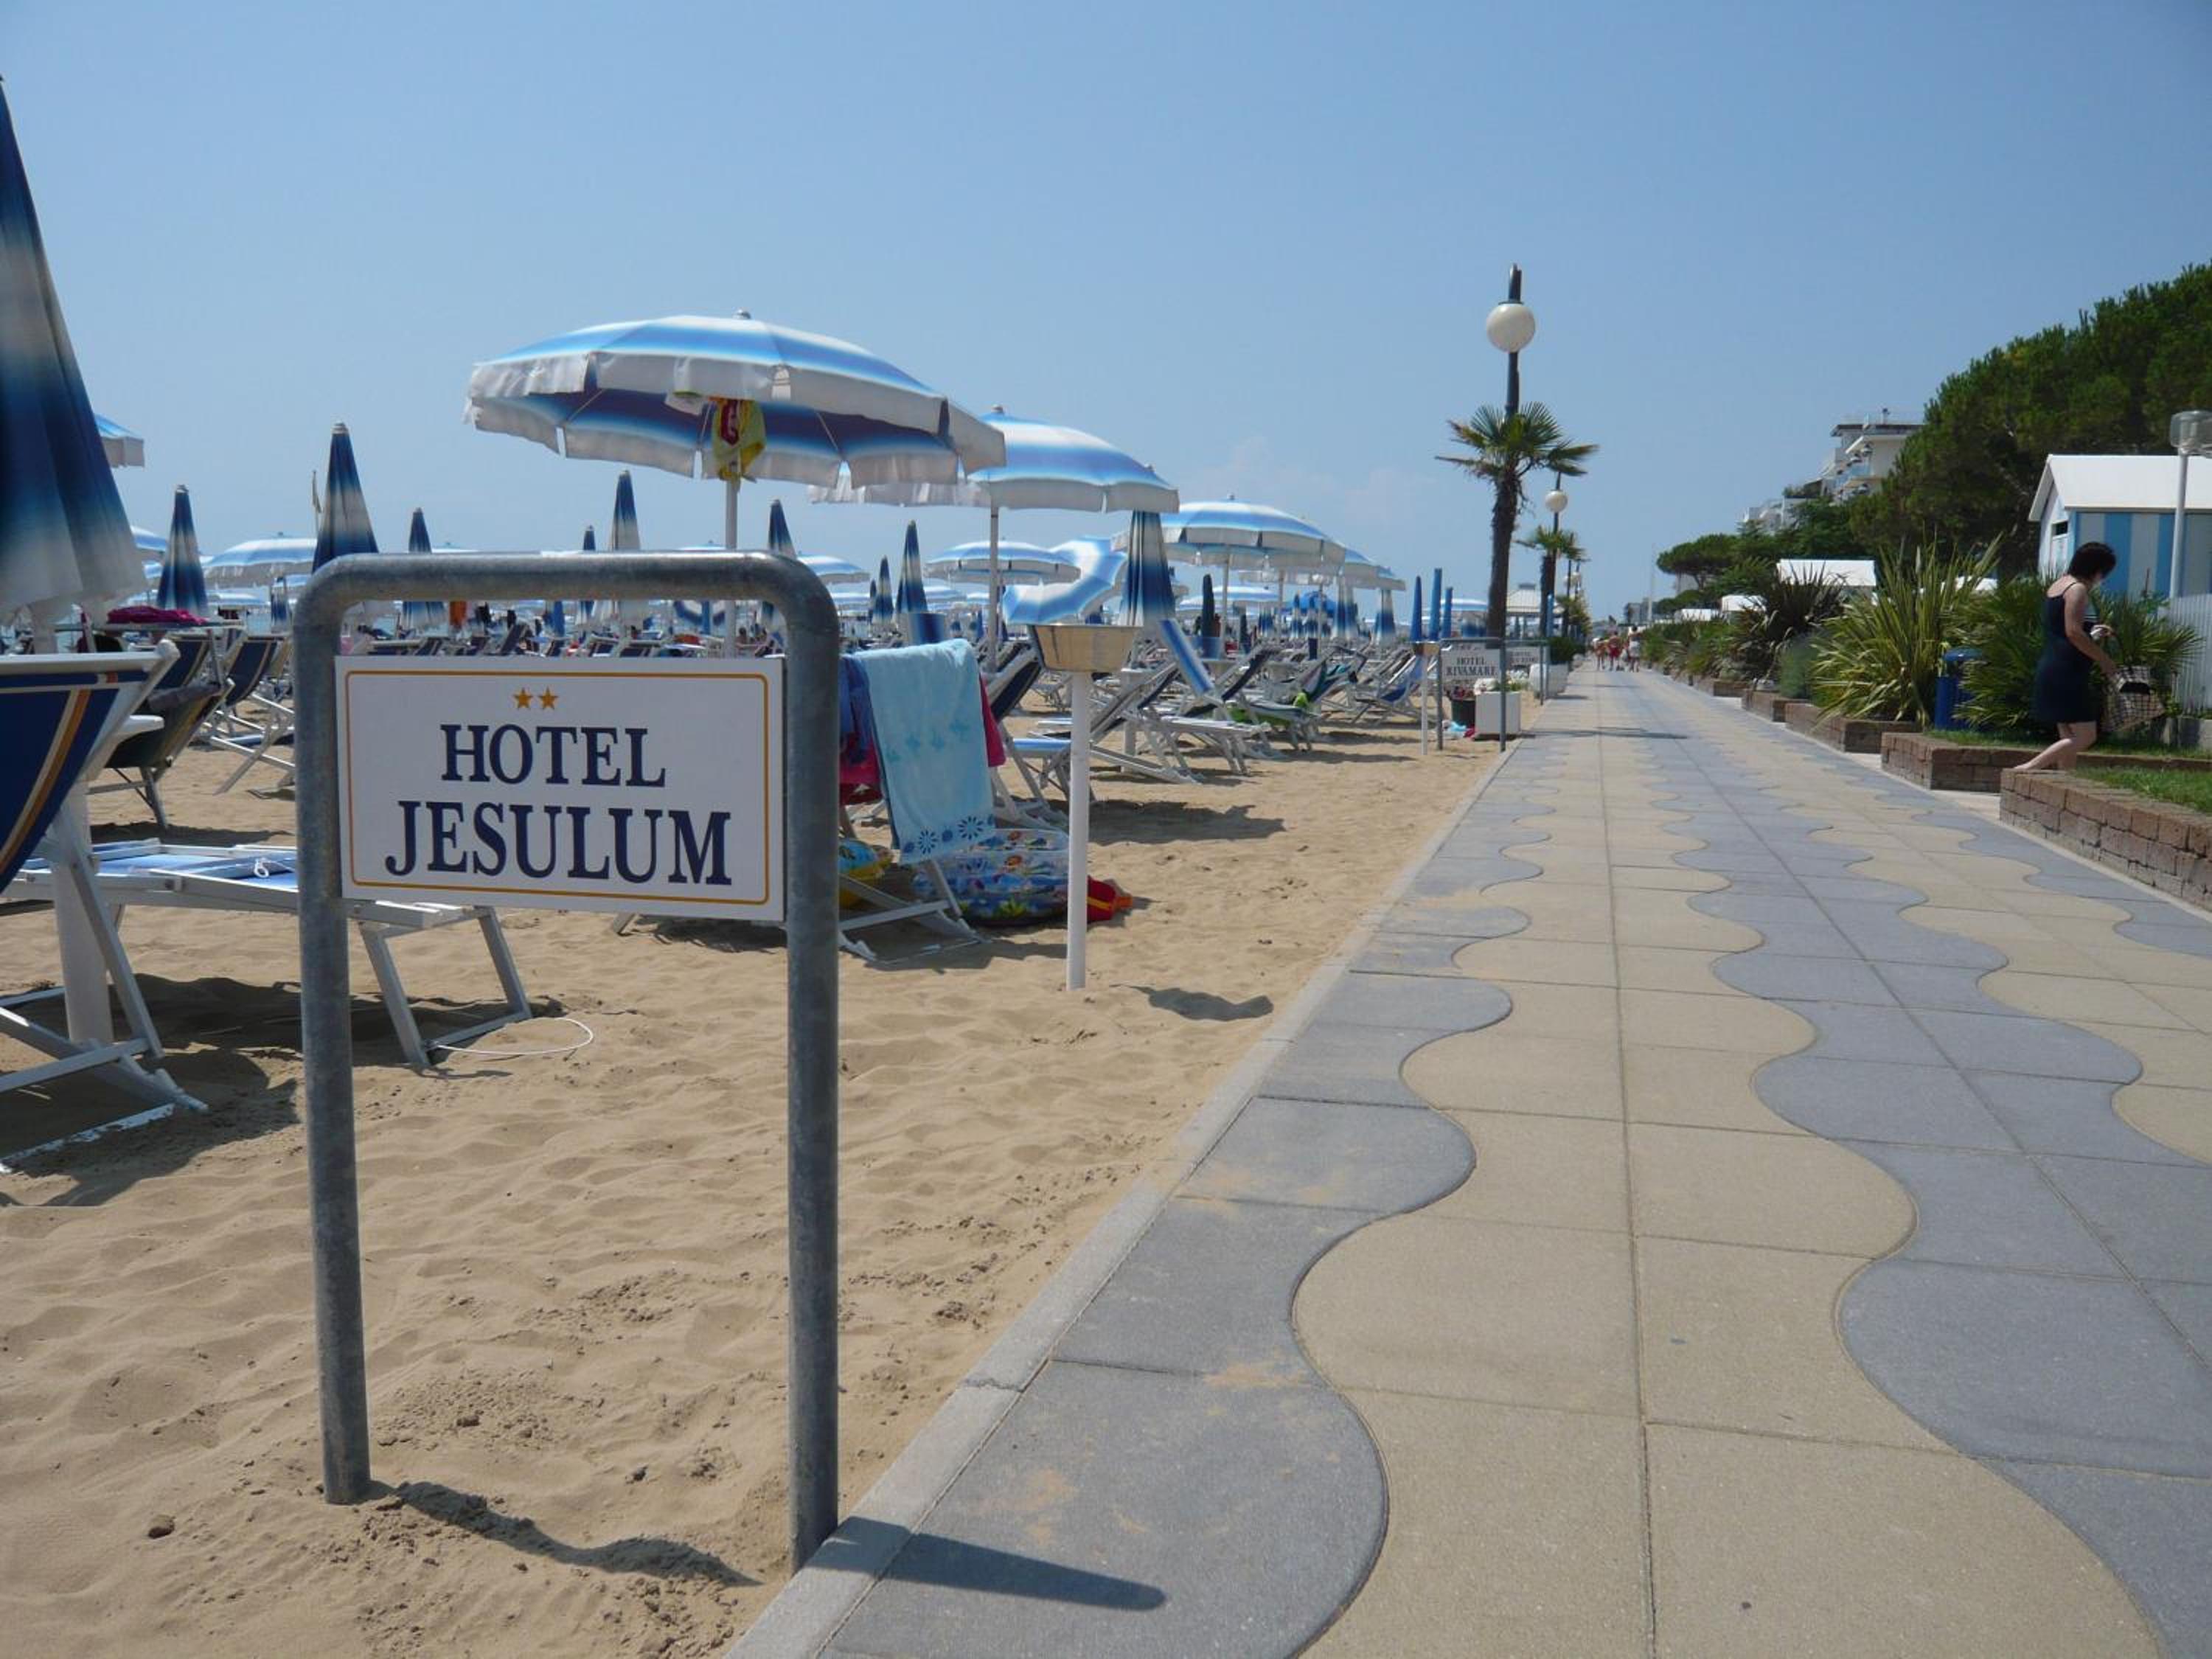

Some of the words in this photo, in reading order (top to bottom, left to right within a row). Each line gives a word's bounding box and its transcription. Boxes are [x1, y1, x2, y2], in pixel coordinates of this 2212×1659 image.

[1456, 656, 1486, 665] HOTEL
[440, 723, 666, 788] HOTEL
[384, 800, 732, 886] JESULUM
